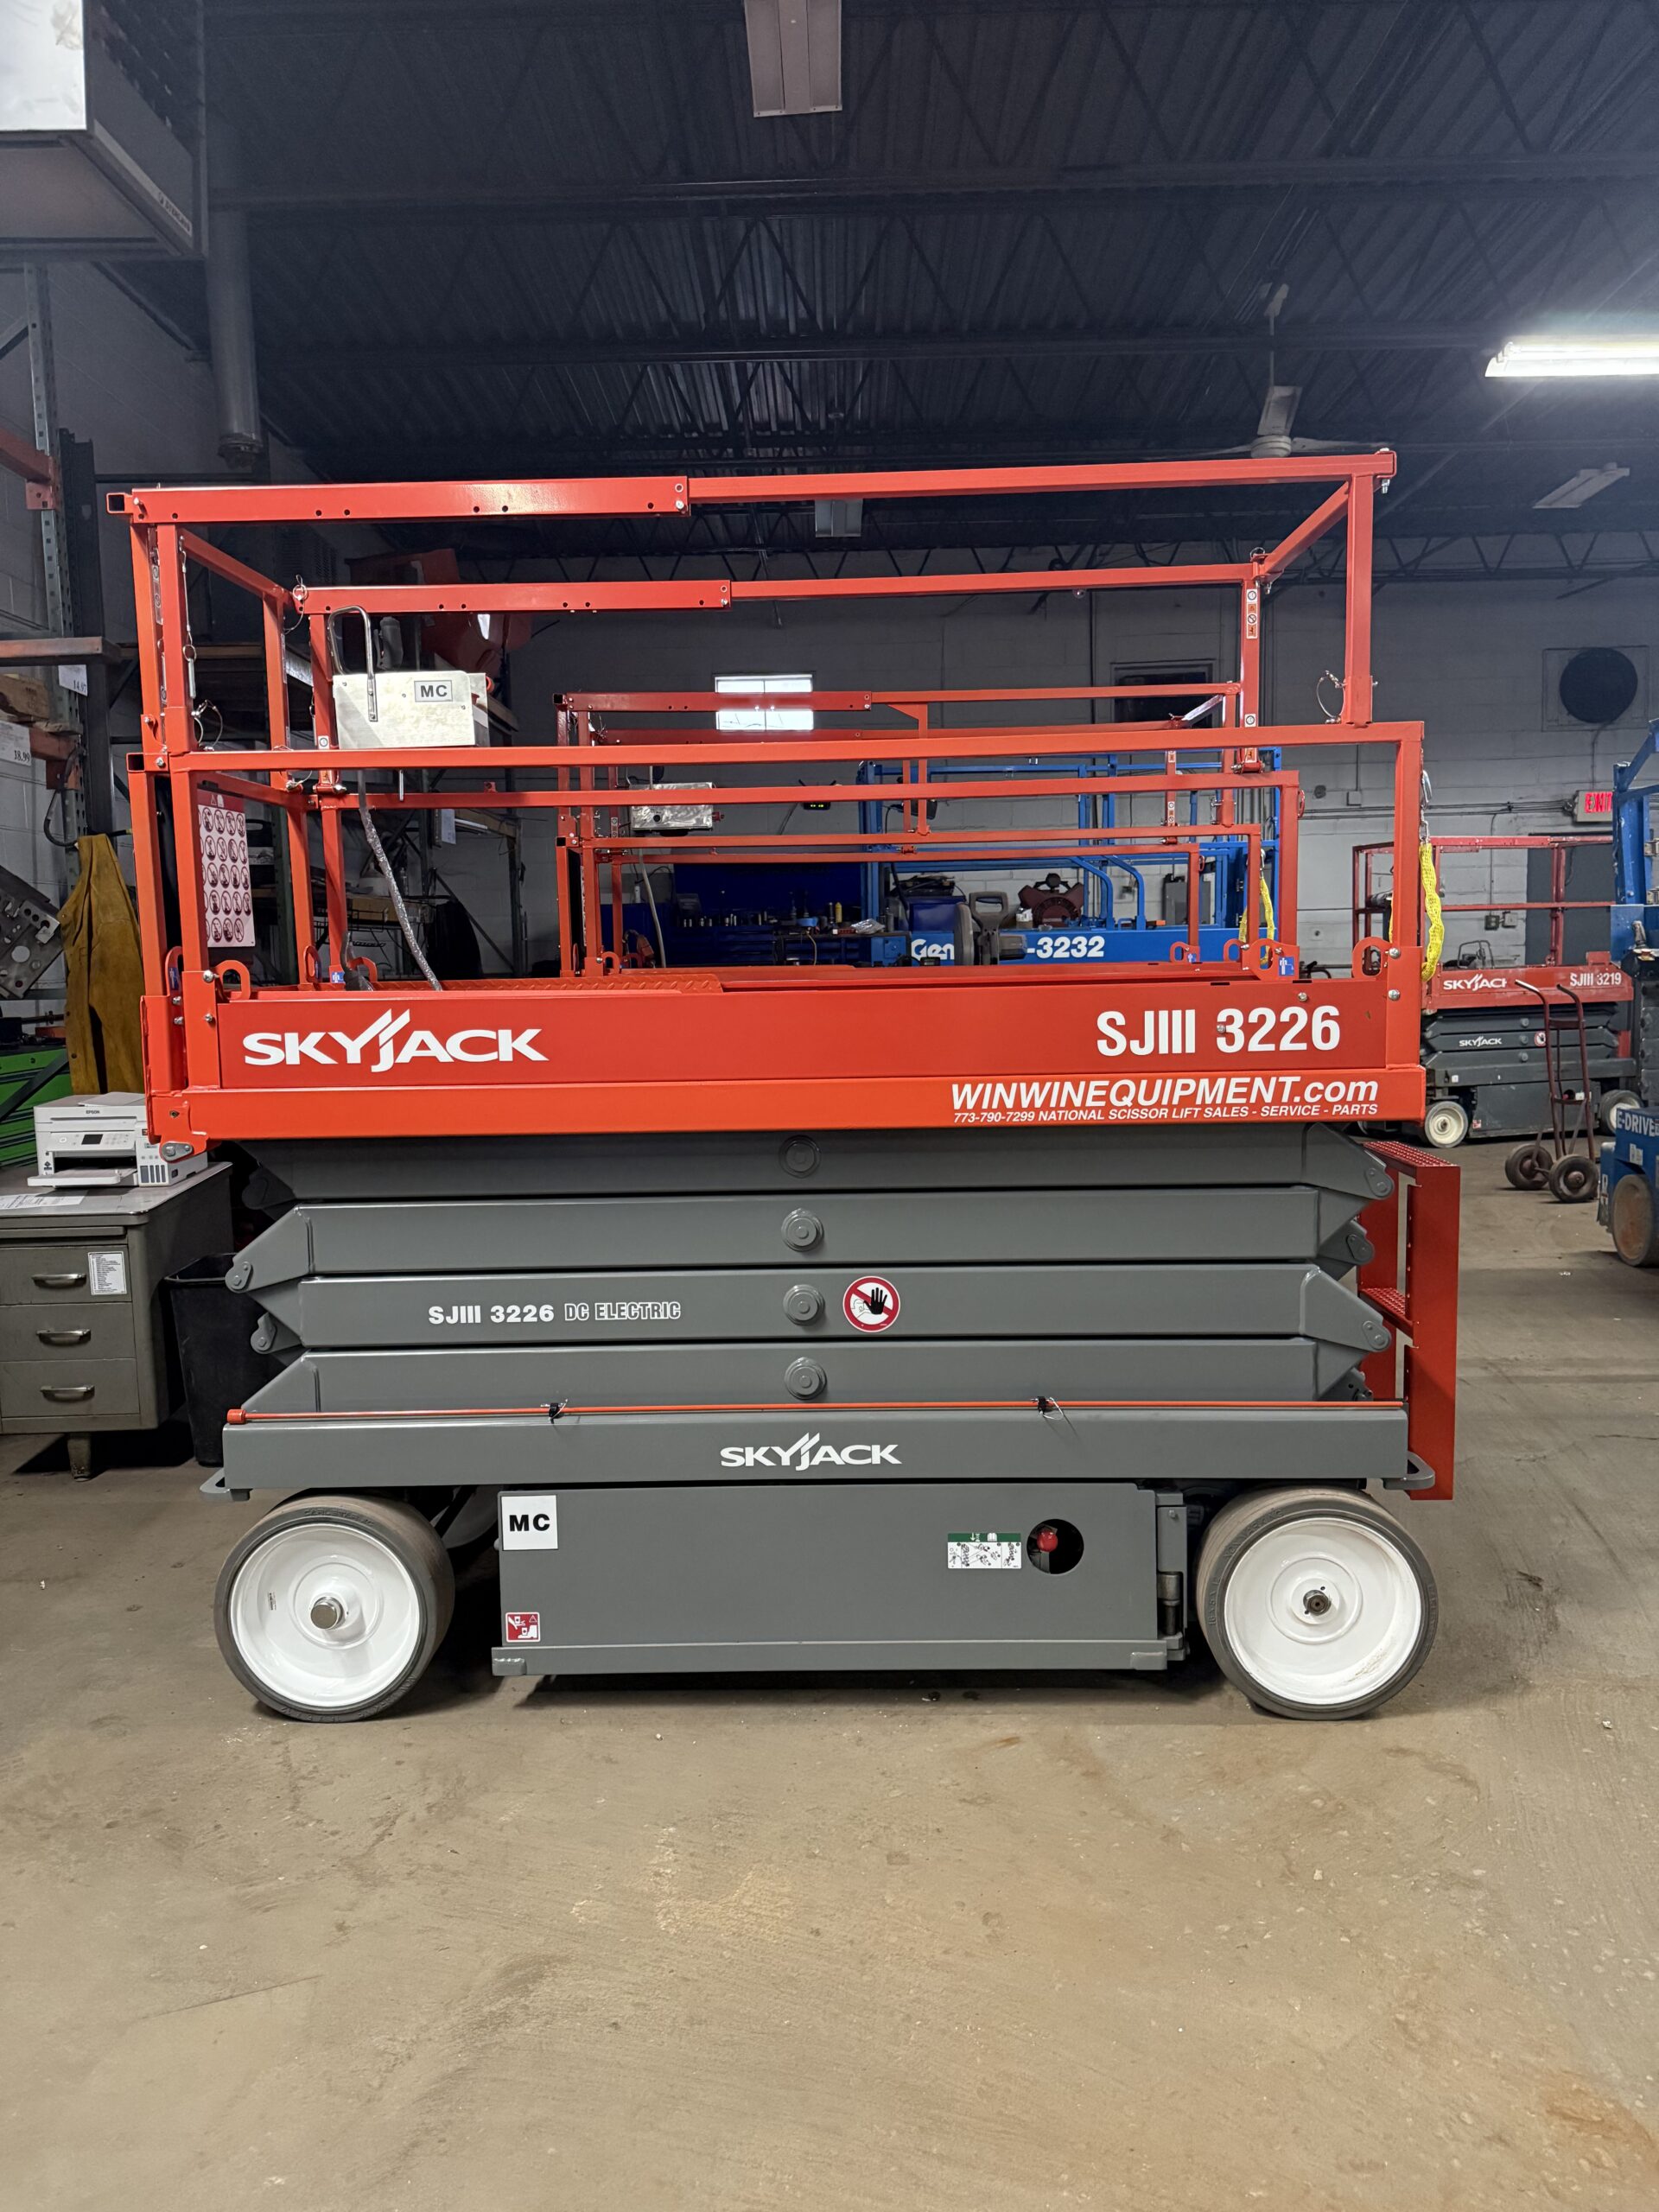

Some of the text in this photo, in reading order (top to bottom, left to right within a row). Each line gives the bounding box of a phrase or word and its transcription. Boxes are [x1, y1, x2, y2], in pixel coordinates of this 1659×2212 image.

[420, 684, 448, 697] MC
[911, 935, 1106, 961] Gen -3232
[1596, 971, 1622, 986] 3219
[242, 1008, 550, 1073] SKYJACK
[1096, 1005, 1341, 1057] SJIII 3226
[1459, 1035, 1503, 1047] SKYJACK
[951, 1076, 1379, 1111] WINWINEQUIPMENT.com
[954, 1111, 1035, 1123] 773-790-7299
[1038, 1109, 1105, 1122] NATIONAL
[1108, 1108, 1168, 1121] SCISSOR
[1172, 1108, 1201, 1119] LIFT
[1203, 1106, 1249, 1118] SALES
[1260, 1104, 1320, 1117] SERVICE
[1332, 1103, 1379, 1116] PARTS
[428, 1301, 681, 1324] SJIII 3226 DC ELECTRIC
[720, 1432, 903, 1471] SKYJACK
[509, 1513, 550, 1532] MC
